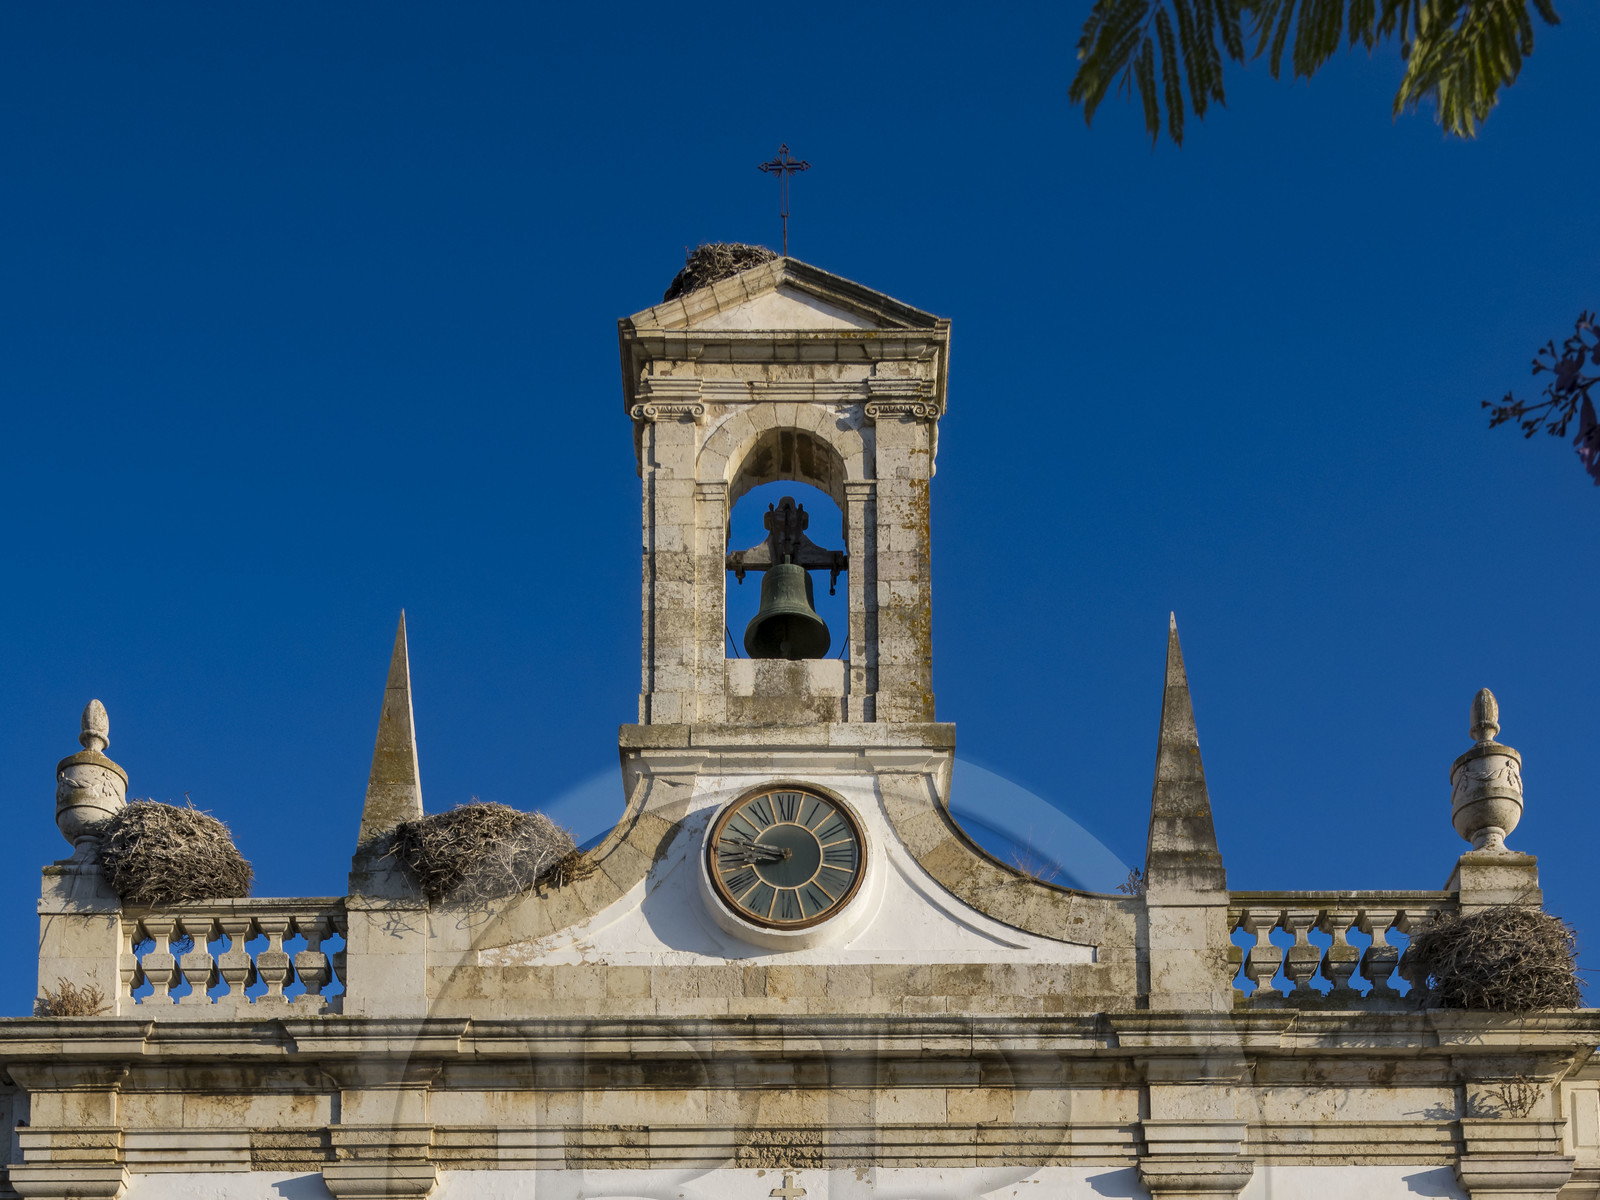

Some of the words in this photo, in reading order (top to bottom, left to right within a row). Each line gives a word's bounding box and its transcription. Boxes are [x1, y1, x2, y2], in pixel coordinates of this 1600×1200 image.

[748, 801, 770, 828] XI
[778, 794, 796, 821] XII
[805, 802, 820, 826] I
[819, 822, 846, 840] II
[825, 848, 853, 862] III
